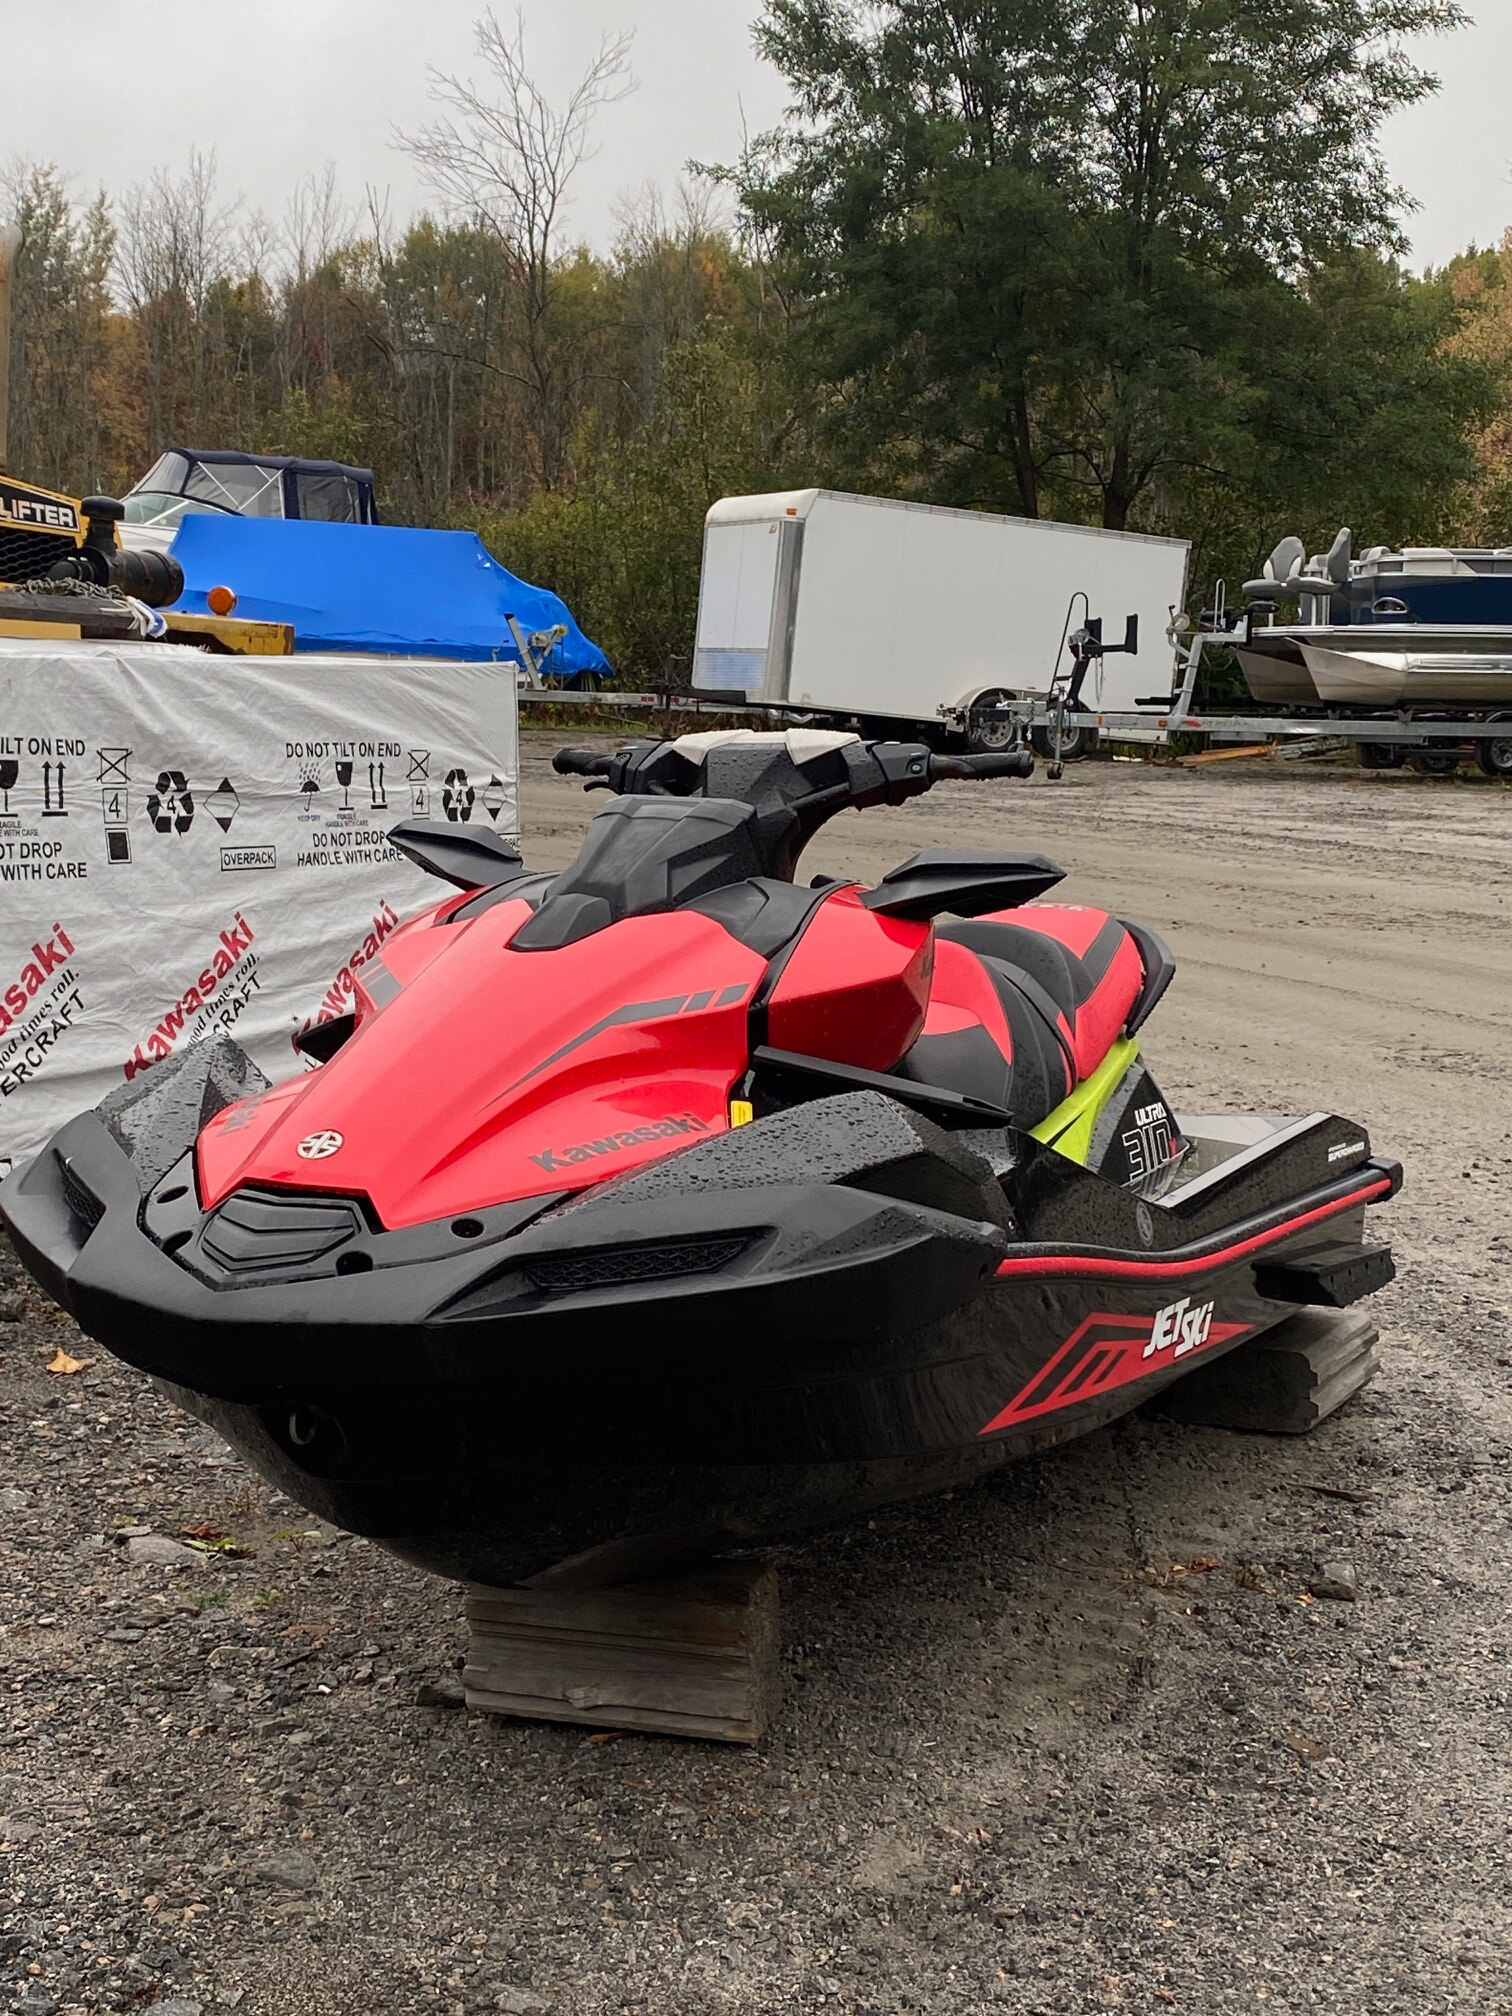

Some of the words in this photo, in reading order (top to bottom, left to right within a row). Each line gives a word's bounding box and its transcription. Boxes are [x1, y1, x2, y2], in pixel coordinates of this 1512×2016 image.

[28, 738, 51, 755] ON
[56, 739, 86, 756] END
[285, 742, 303, 758] DO
[305, 742, 330, 758] NOT
[332, 742, 356, 758] TILT
[359, 742, 375, 758] ON
[377, 742, 401, 758] END
[312, 833, 328, 848] DO
[330, 832, 352, 847] NOT
[355, 830, 386, 846] DROP
[20, 842, 62, 859] DROP
[224, 852, 275, 866] OVERPACK
[297, 850, 342, 867] HANDLE
[343, 849, 372, 865] WITH
[374, 847, 404, 863] CARE
[0, 863, 42, 881] WITH
[46, 862, 87, 880] CARE
[234, 953, 260, 982] roll.
[20, 999, 53, 1042] times
[50, 968, 80, 1002] roll.
[123, 911, 256, 1081] Kawasaki
[0, 988, 85, 1097] ERCRAFT
[1134, 1101, 1167, 1126] ULTRA
[528, 1112, 711, 1174] Kawasaki
